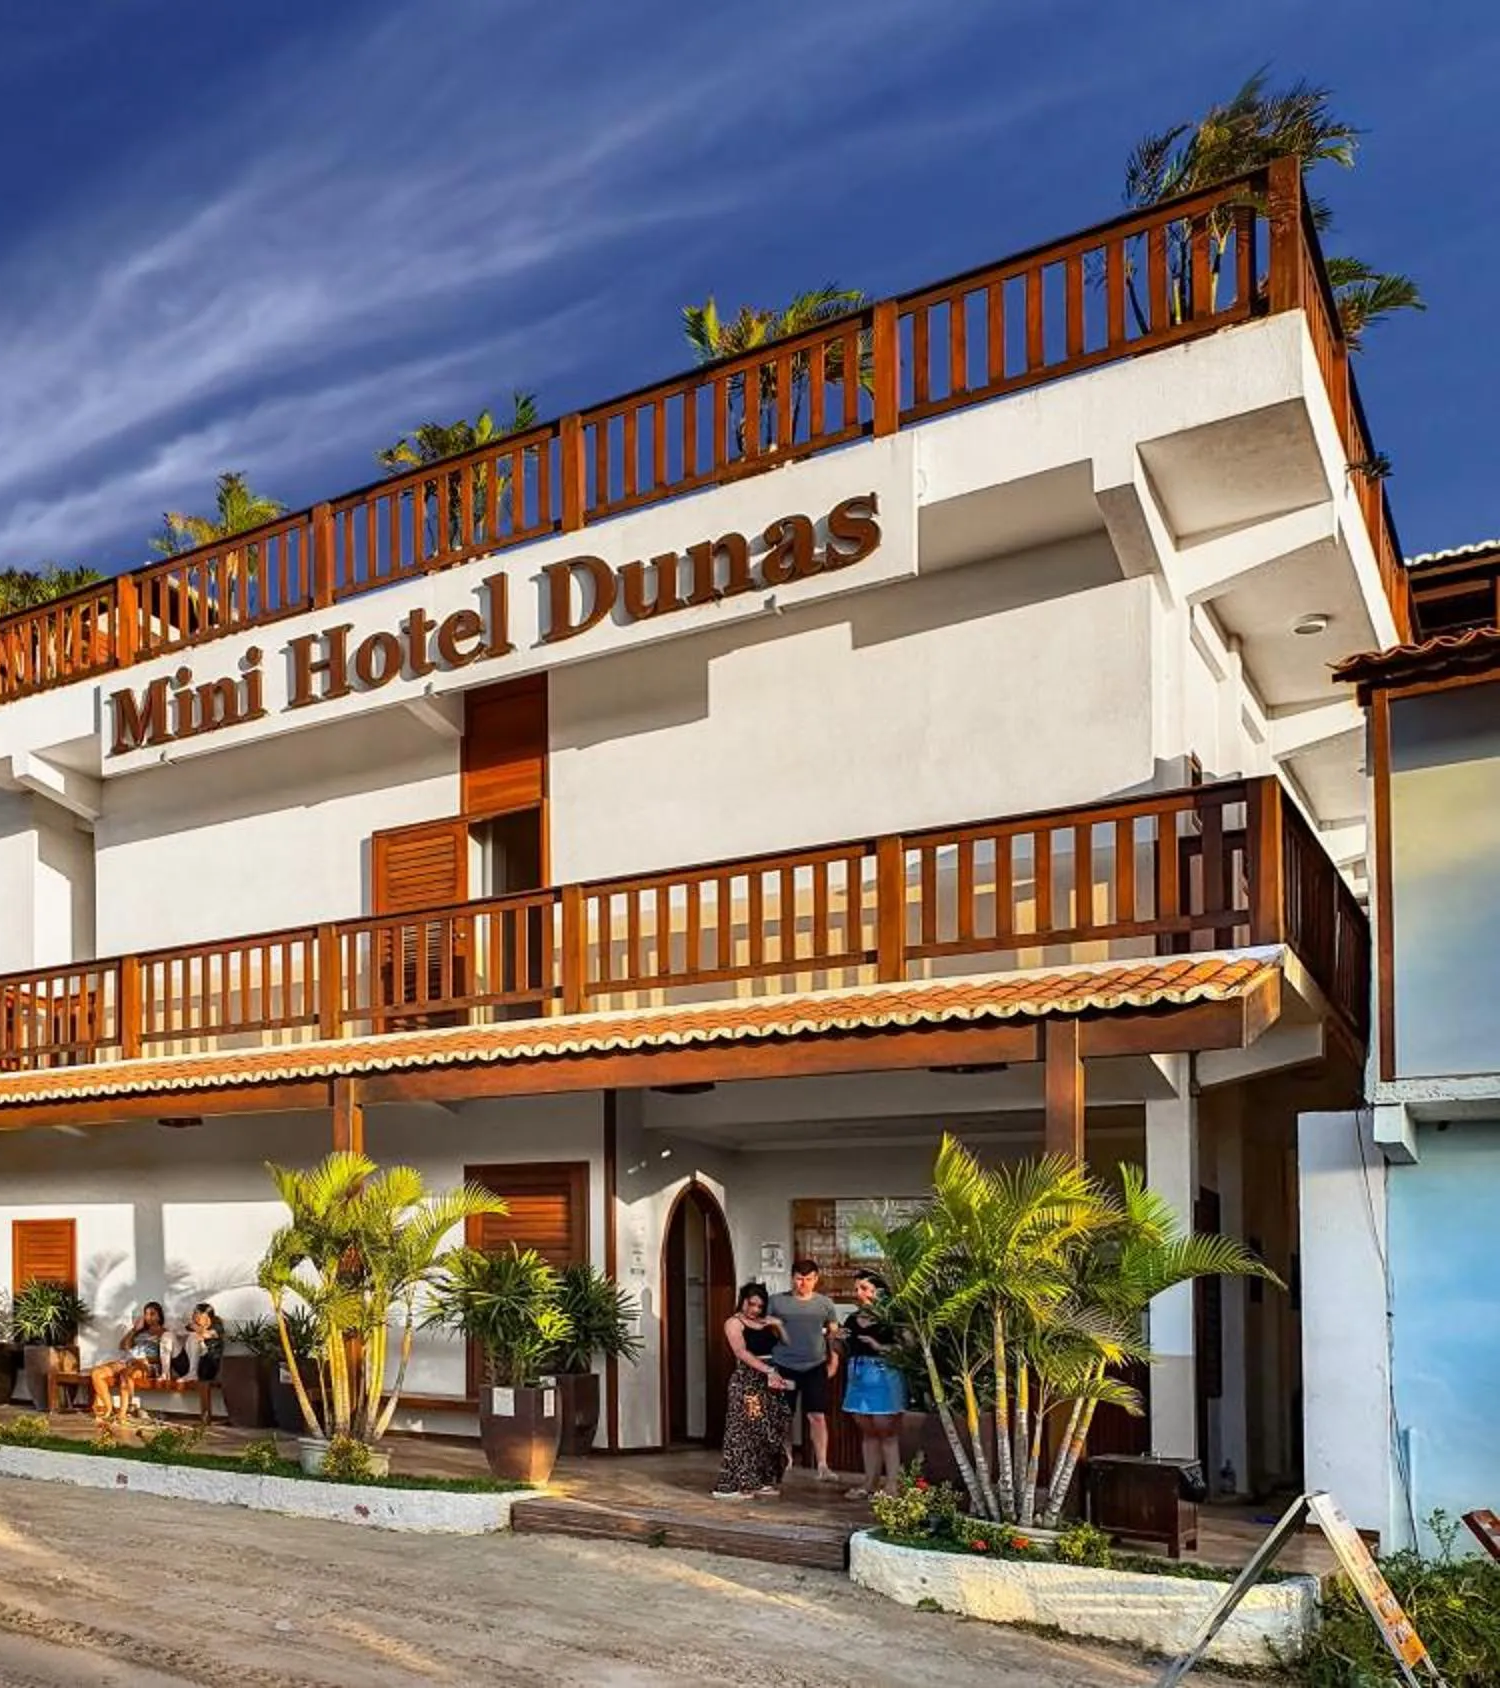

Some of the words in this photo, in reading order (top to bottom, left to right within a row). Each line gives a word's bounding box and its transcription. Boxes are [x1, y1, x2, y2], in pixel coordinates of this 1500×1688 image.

[109, 646, 268, 755] Mini
[286, 571, 516, 709] Hotel
[540, 491, 882, 643] Dunas
